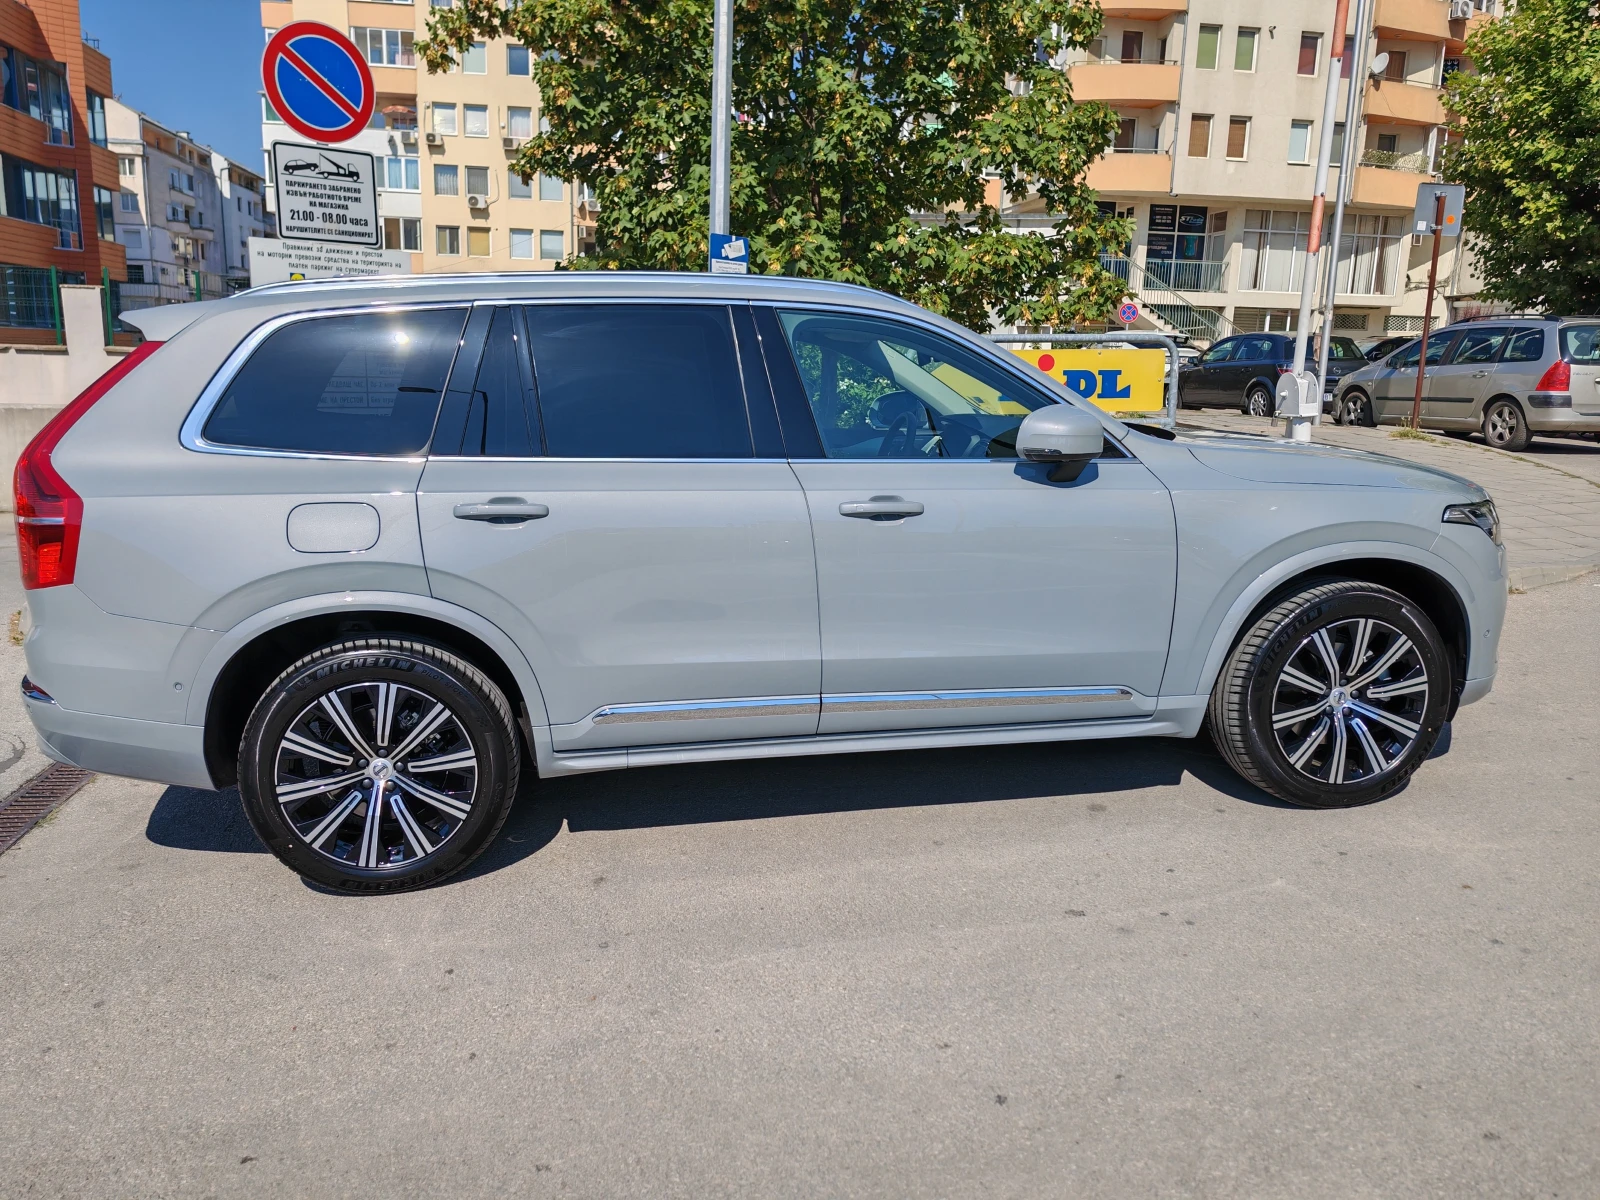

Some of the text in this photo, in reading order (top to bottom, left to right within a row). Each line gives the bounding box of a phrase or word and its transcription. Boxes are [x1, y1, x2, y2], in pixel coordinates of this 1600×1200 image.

[285, 180, 361, 194] ПАРКИРАНЕТО ЗАБРАНЕНО
[286, 189, 307, 197] ИЗВЪН
[308, 191, 342, 201] РАБОТНОТО
[318, 202, 349, 210] МАГАЗИНА
[290, 209, 314, 222] 21.00
[322, 212, 347, 225] 08.00
[349, 218, 369, 227] часа
[285, 226, 326, 235] НАРУШИТЕЛИТЕ
[334, 229, 374, 239] САНКЦИОНИРАТ
[282, 242, 313, 252] Правилник
[325, 247, 353, 256] движение
[362, 250, 383, 258] престой
[267, 252, 292, 260] моторни
[324, 256, 350, 264] средства
[360, 260, 393, 268] територията
[311, 264, 334, 272] паркинг
[345, 267, 380, 275] супермаркет
[1262, 608, 1320, 672] MICHELIN
[316, 657, 410, 680] MICHELIN
[421, 669, 443, 682] PILOT
